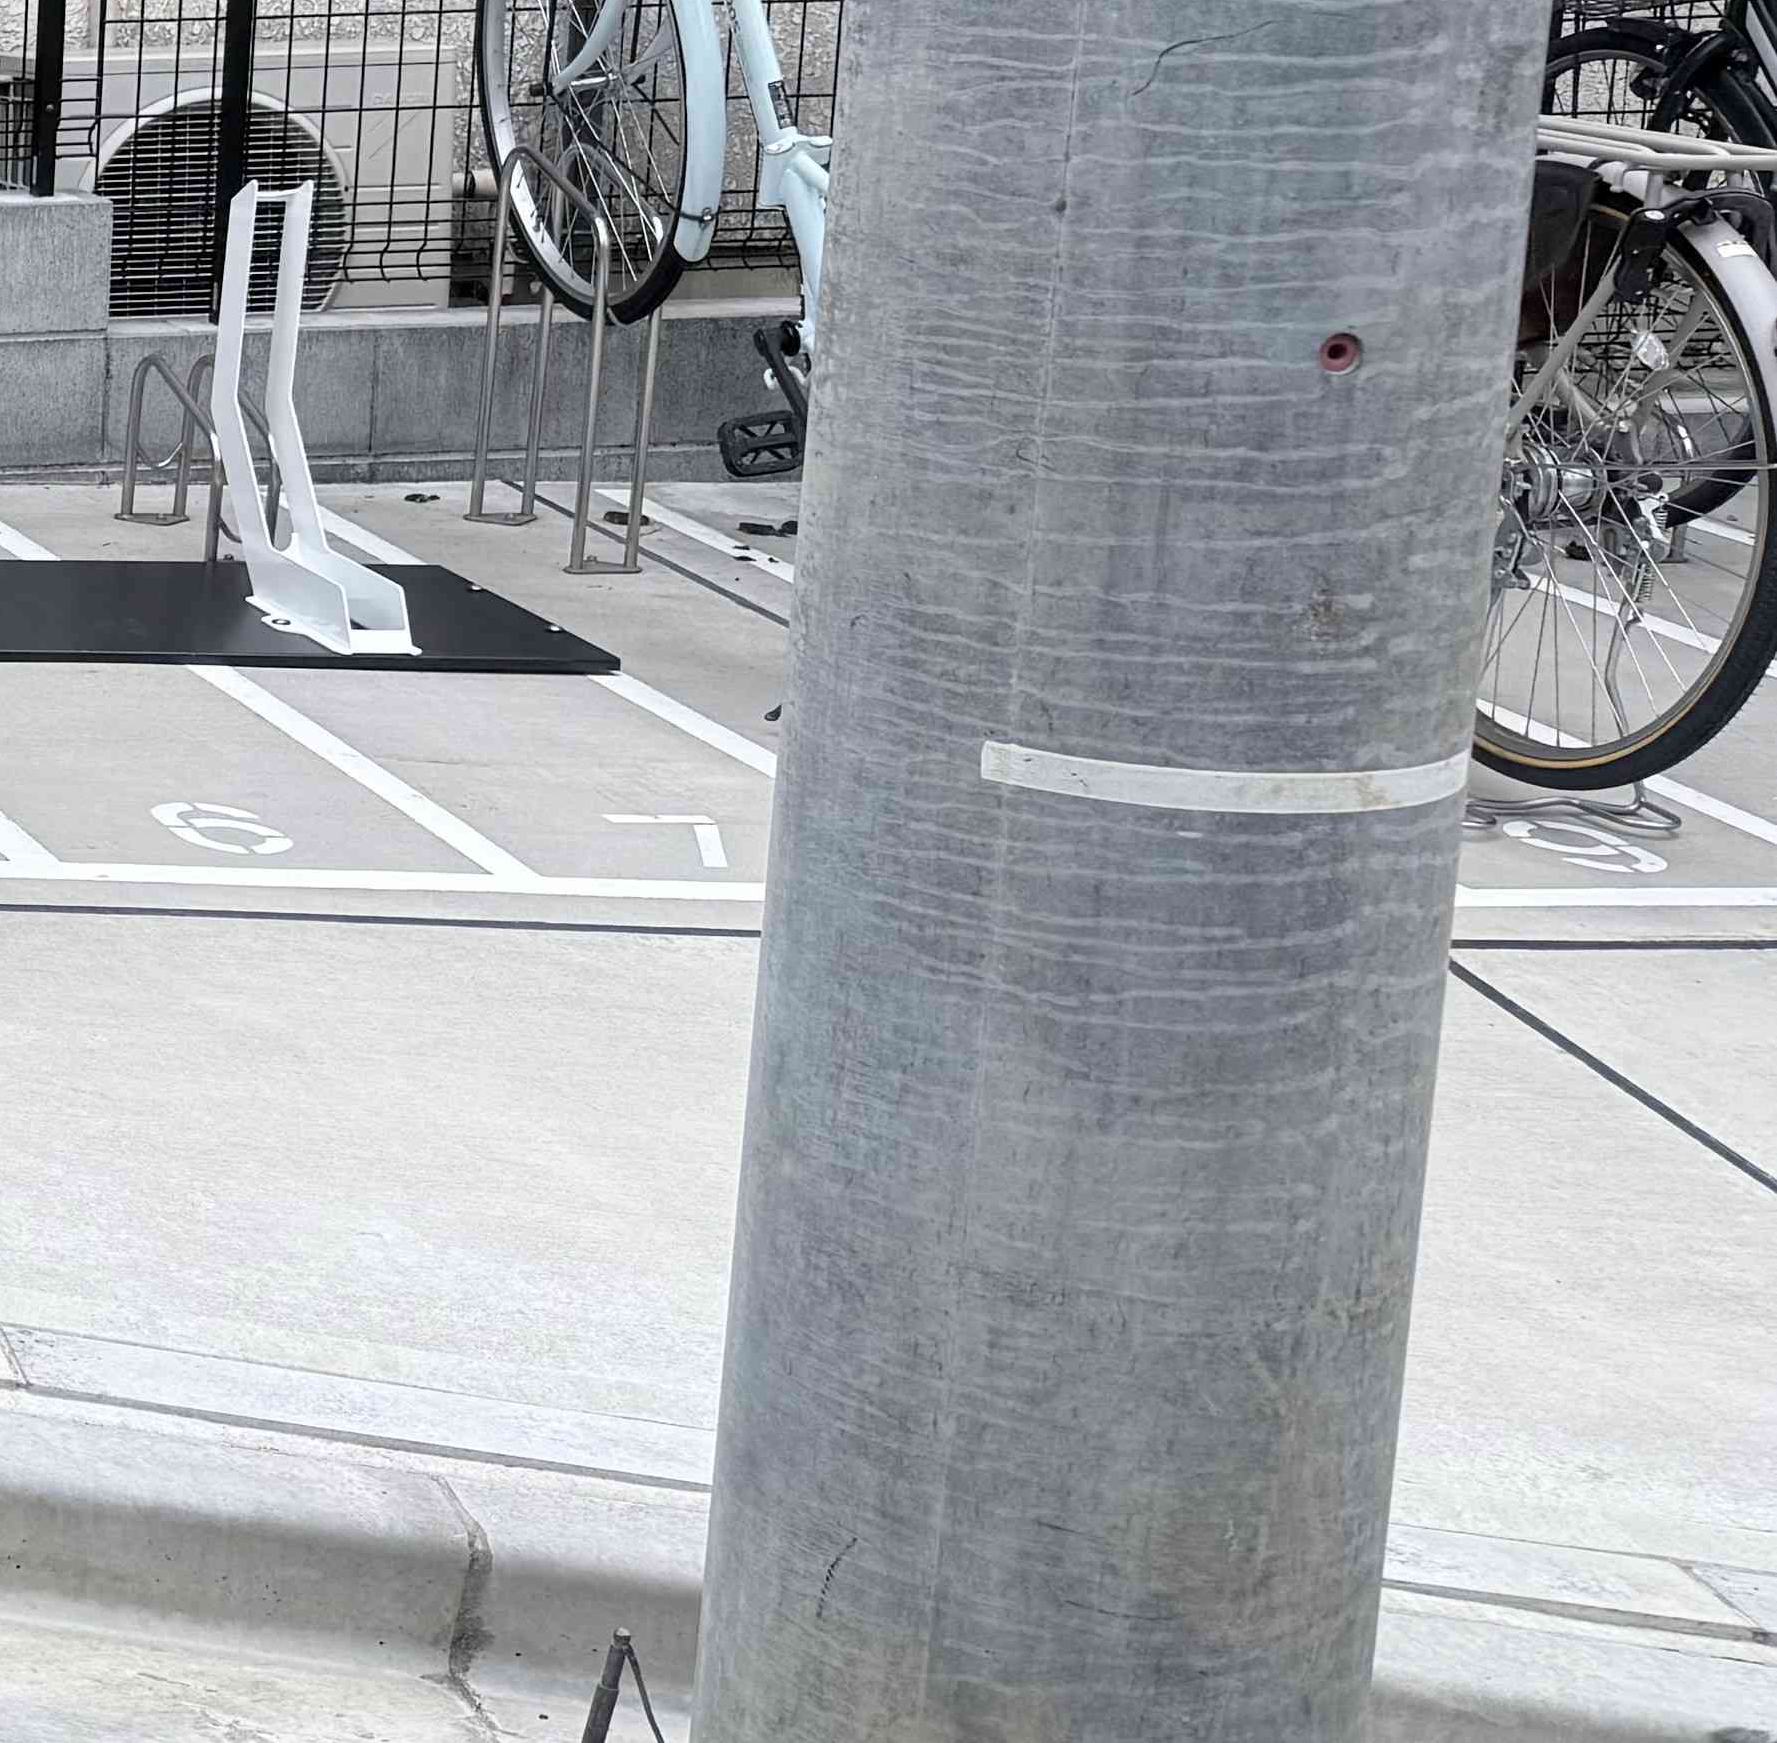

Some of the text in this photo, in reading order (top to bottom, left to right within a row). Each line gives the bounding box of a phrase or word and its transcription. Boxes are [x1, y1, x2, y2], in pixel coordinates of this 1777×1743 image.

[150, 802, 294, 854] 6
[601, 813, 728, 868] 7
[1502, 820, 1669, 874] 9
